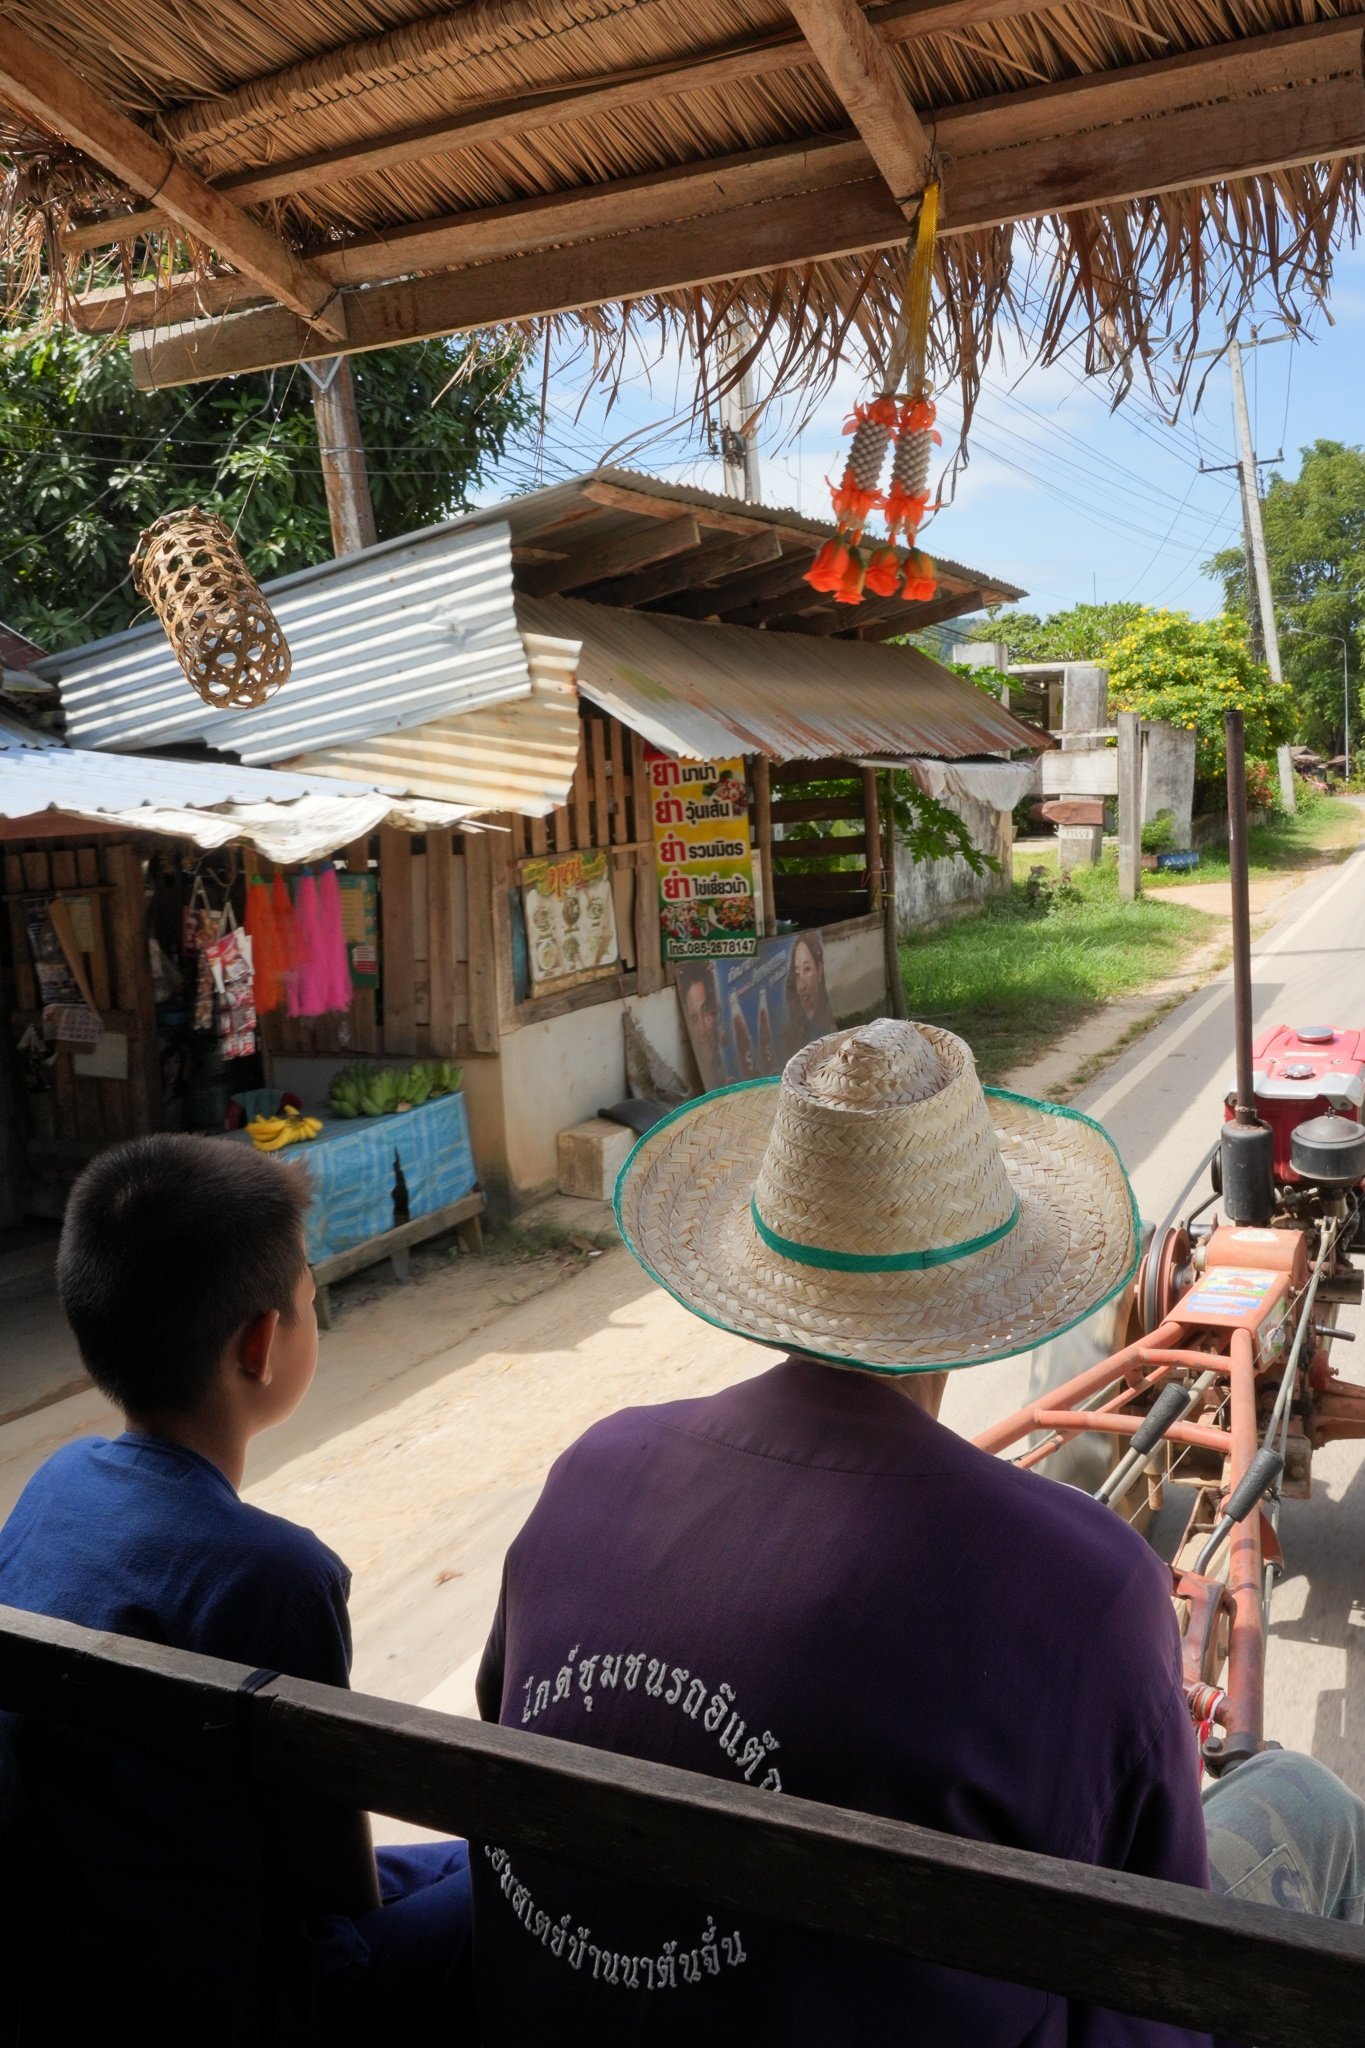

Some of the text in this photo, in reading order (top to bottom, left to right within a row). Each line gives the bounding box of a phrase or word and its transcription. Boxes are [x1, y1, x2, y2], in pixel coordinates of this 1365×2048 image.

[682, 762, 716, 782] มาม่า
[656, 791, 730, 825] ยำ วุ้นเส้น
[660, 833, 744, 862] ยำ รวมมิตร
[664, 870, 747, 899] ยำ ไข่เยี่ยวม้า
